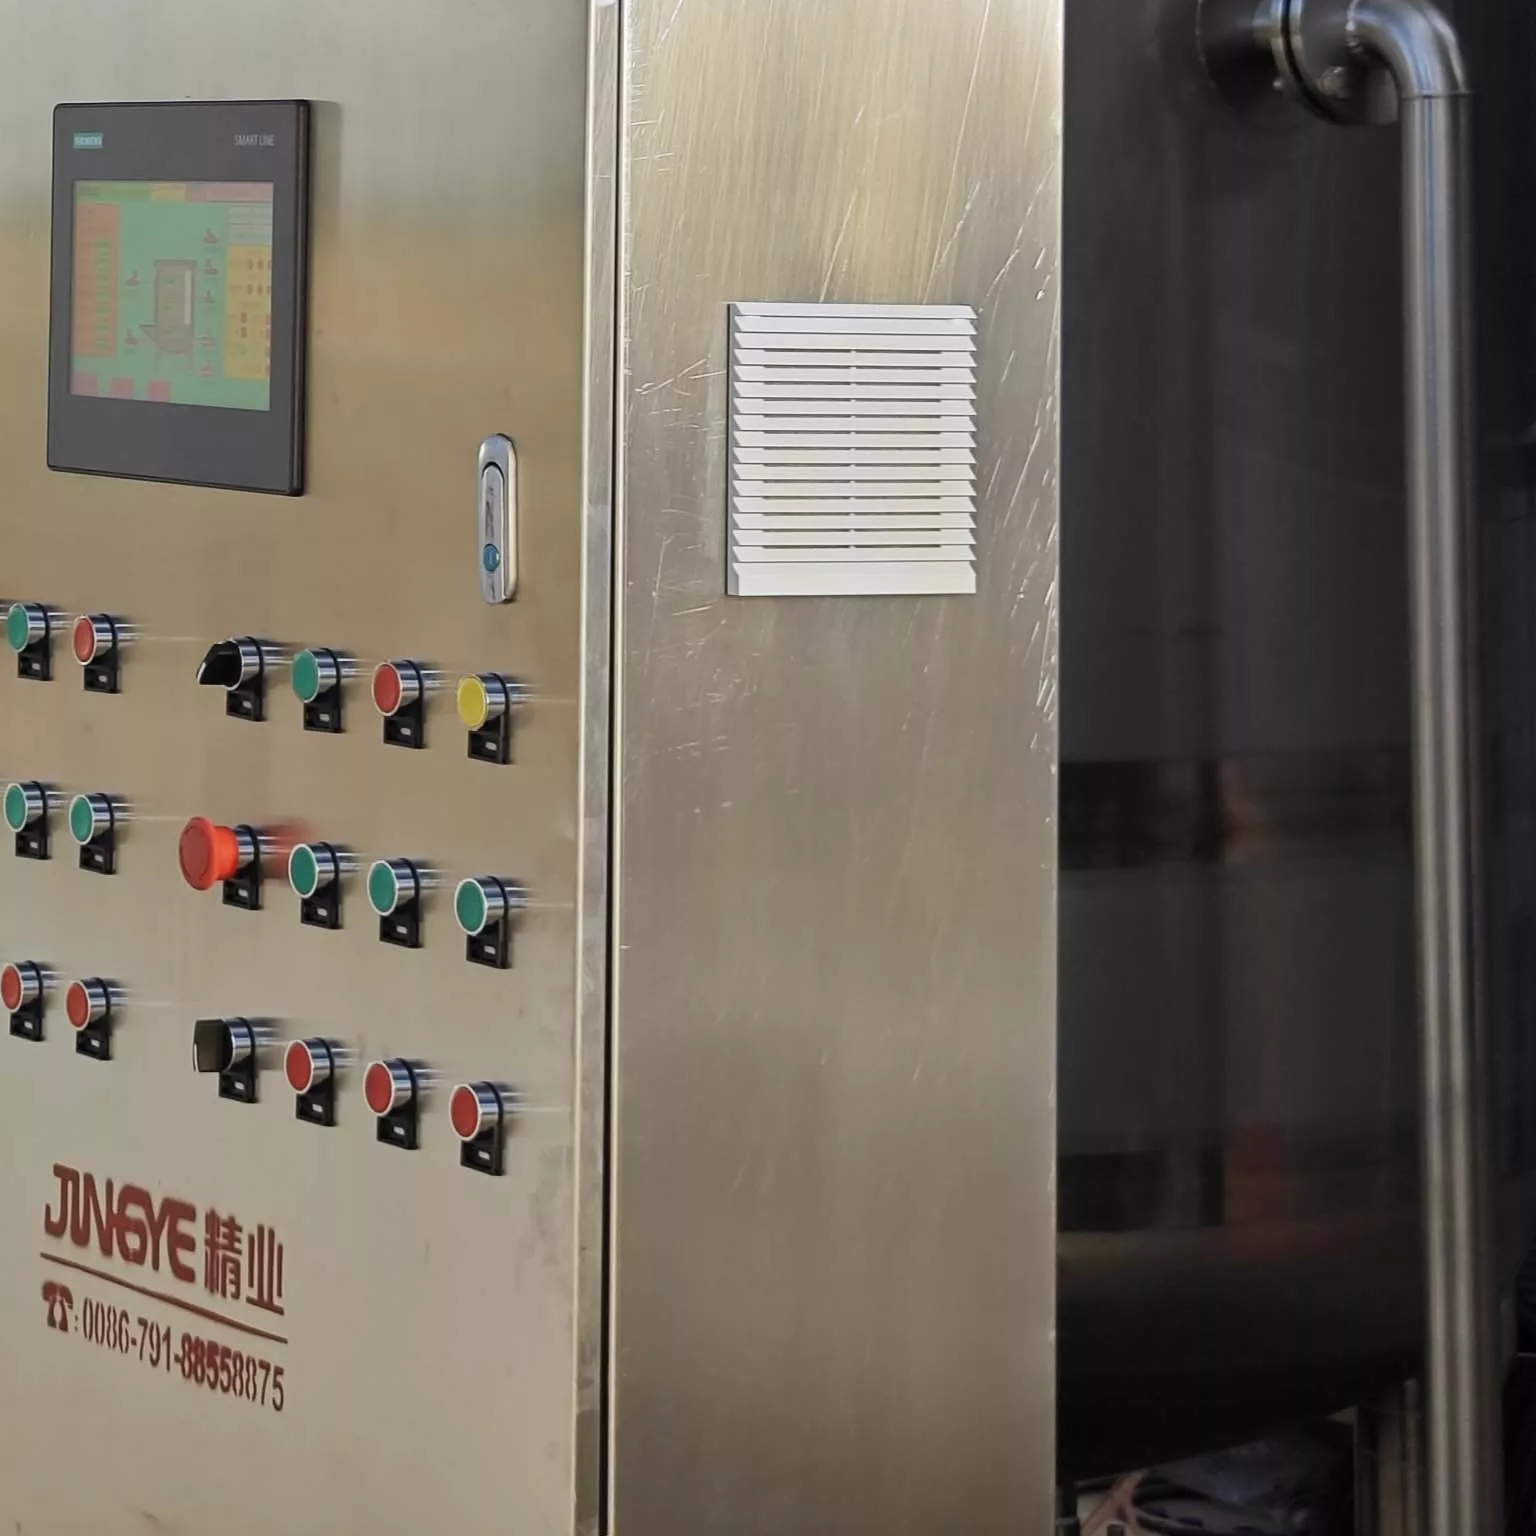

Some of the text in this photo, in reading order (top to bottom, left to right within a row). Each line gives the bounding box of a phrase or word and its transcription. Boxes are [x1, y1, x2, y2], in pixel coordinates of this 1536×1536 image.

[233, 134, 258, 146] SMART
[44, 1162, 285, 1316] JINGYE 精业
